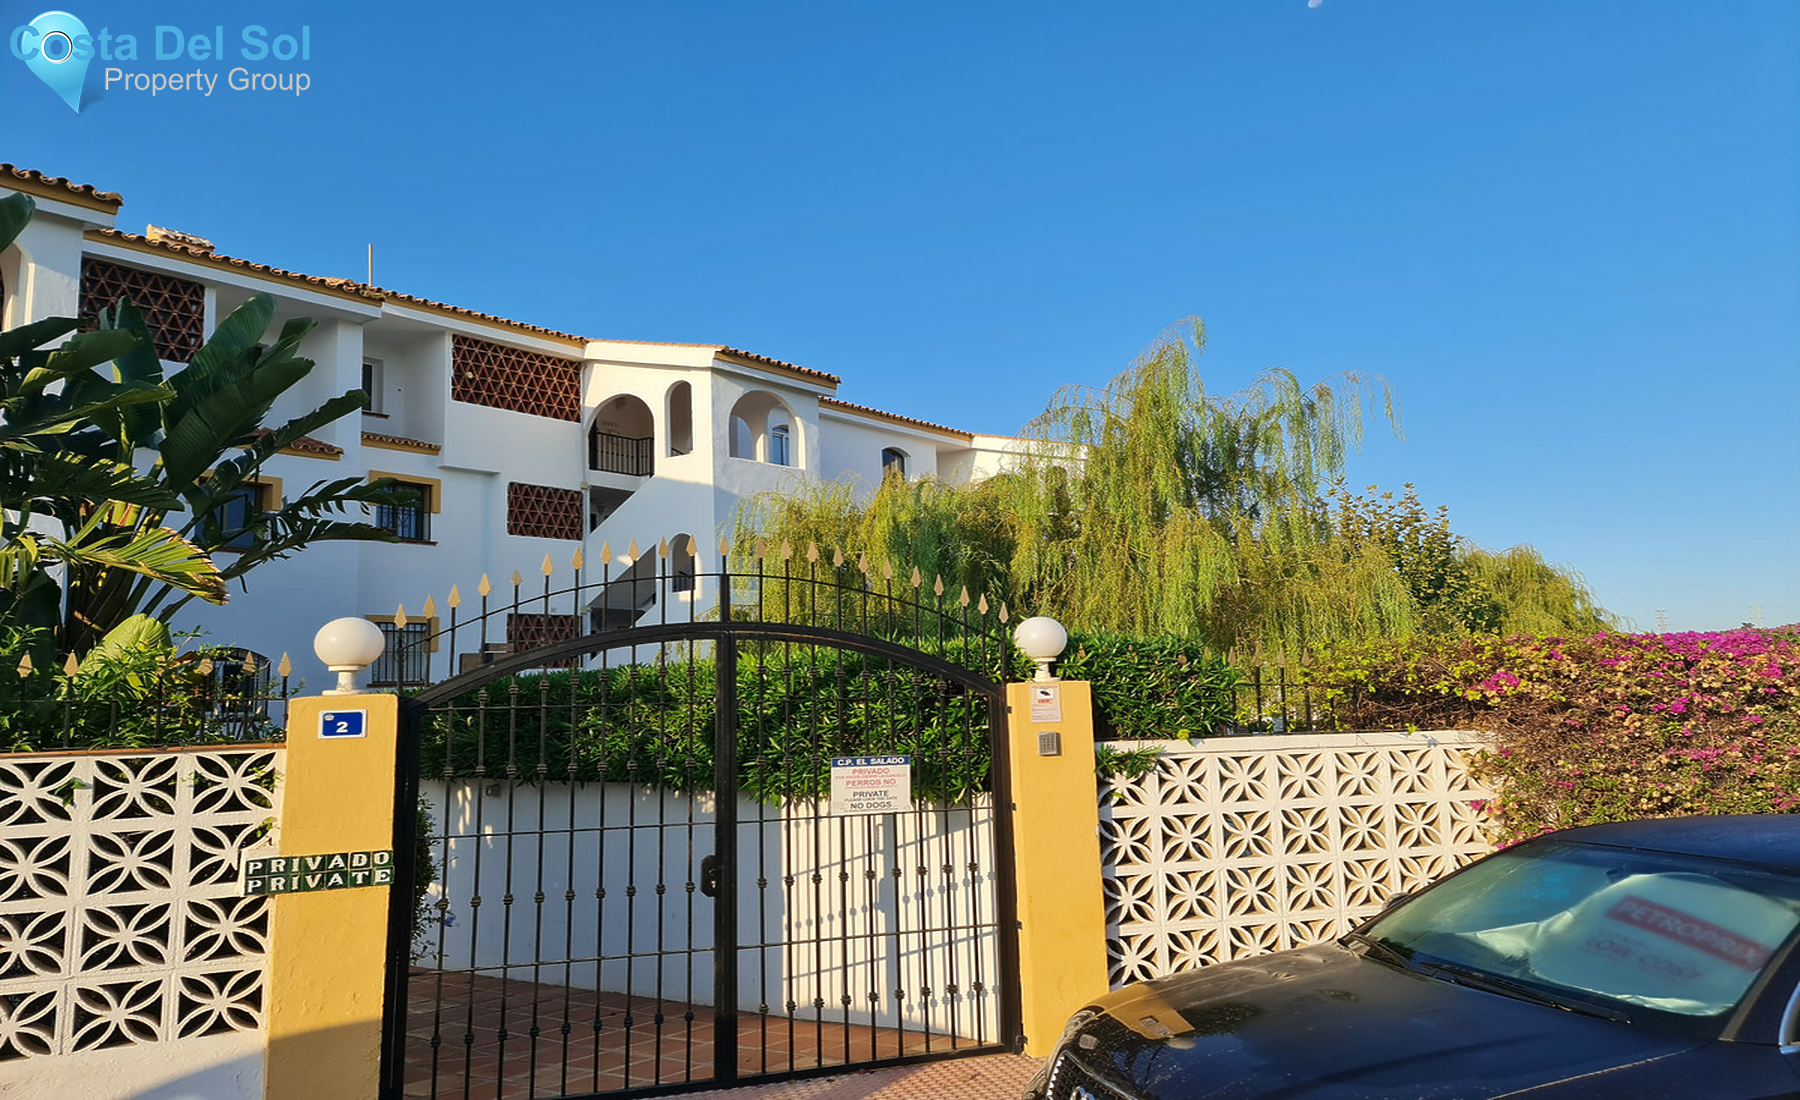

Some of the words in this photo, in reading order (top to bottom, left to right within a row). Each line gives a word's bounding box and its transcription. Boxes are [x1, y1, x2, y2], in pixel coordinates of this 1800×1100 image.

[336, 721, 348, 733] 2
[837, 758, 854, 766] C.P.
[870, 757, 904, 765] SALADO
[845, 779, 881, 787] PERROS
[852, 790, 888, 798] PRIVATE
[248, 851, 390, 872] PRIVADO
[247, 869, 391, 893] PRIVATE
